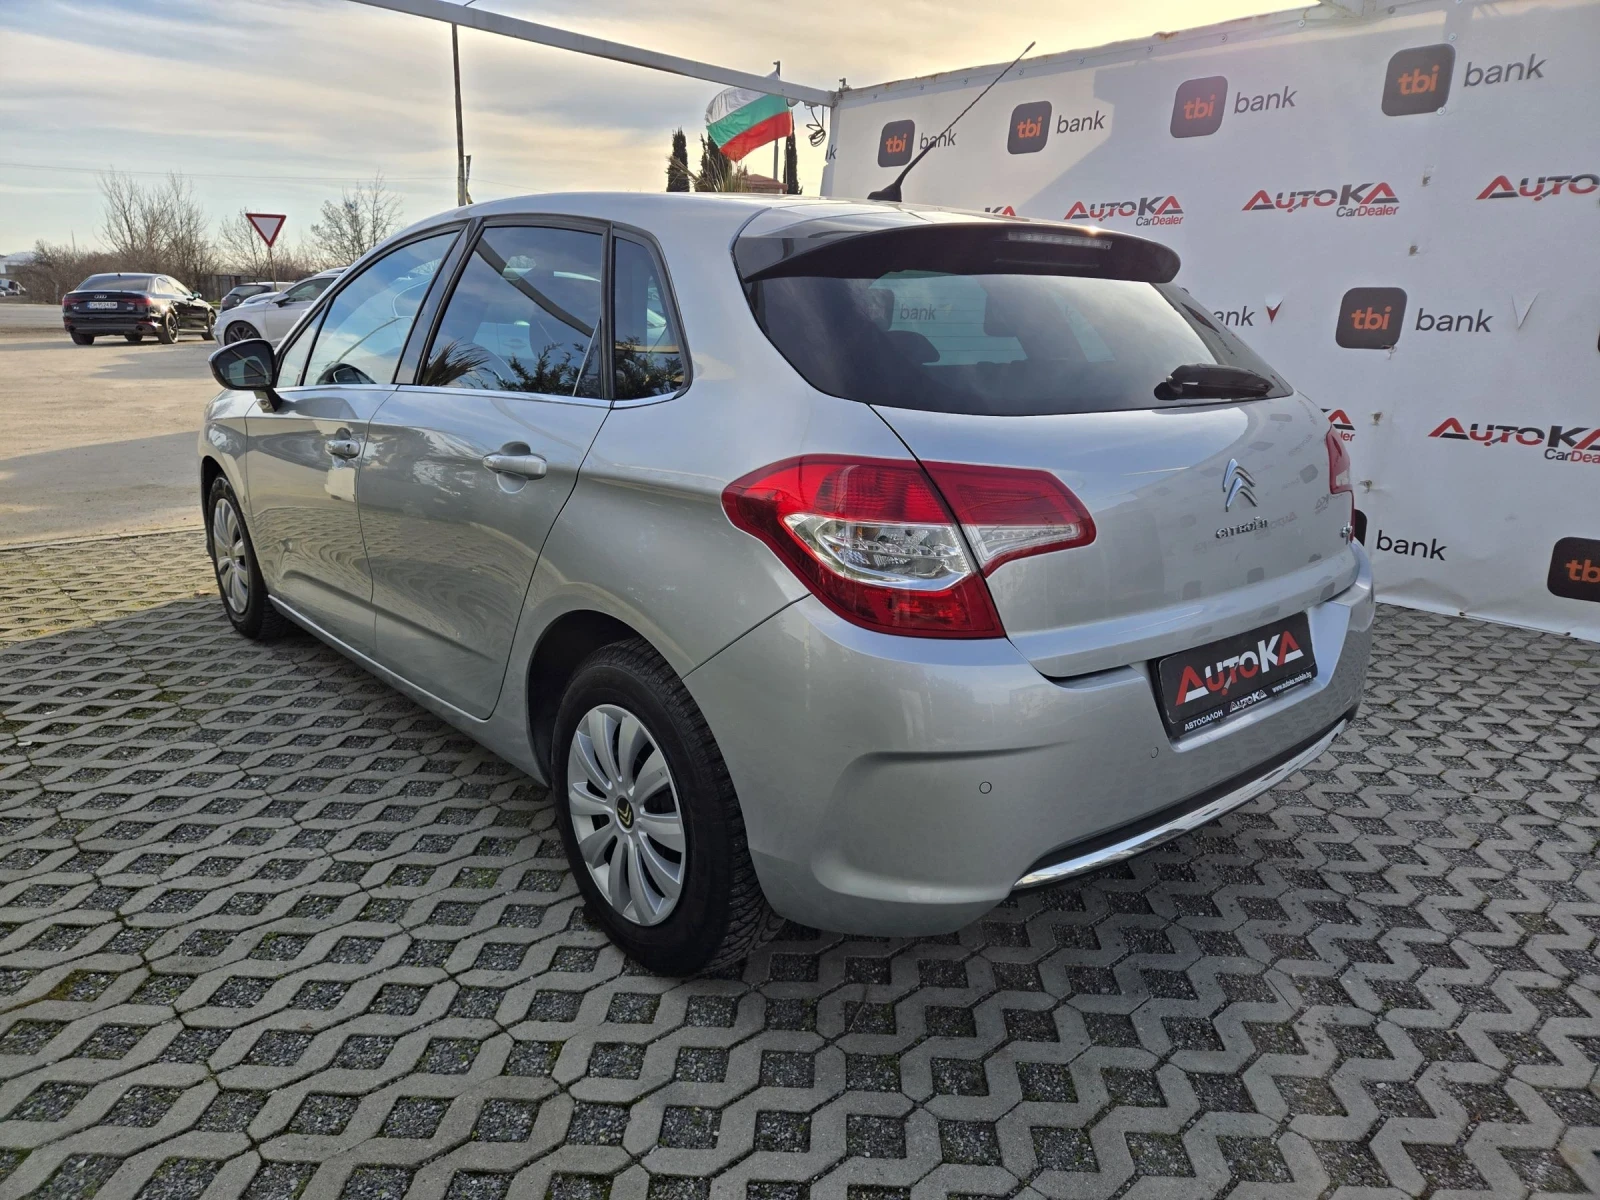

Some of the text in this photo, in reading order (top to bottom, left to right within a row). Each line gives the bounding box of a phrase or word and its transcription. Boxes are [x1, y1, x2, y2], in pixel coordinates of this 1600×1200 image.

[1397, 53, 1548, 96] tbi bank
[1183, 86, 1297, 121] tbi bank
[1017, 111, 1105, 139] tbi bank
[885, 133, 908, 153] tbi
[1064, 195, 1184, 222] AUTOKA
[1241, 182, 1400, 213] AUTOKA
[1336, 204, 1400, 218] CarDealer
[1135, 213, 1184, 228] CarDealer
[899, 303, 937, 321] bank
[1351, 305, 1494, 333] tbi bank
[1376, 530, 1448, 561] bank
[1175, 630, 1304, 706] AUTOKA
[1229, 689, 1268, 713] AUTOKA
[1184, 709, 1224, 732] АВТОСАЛОН
